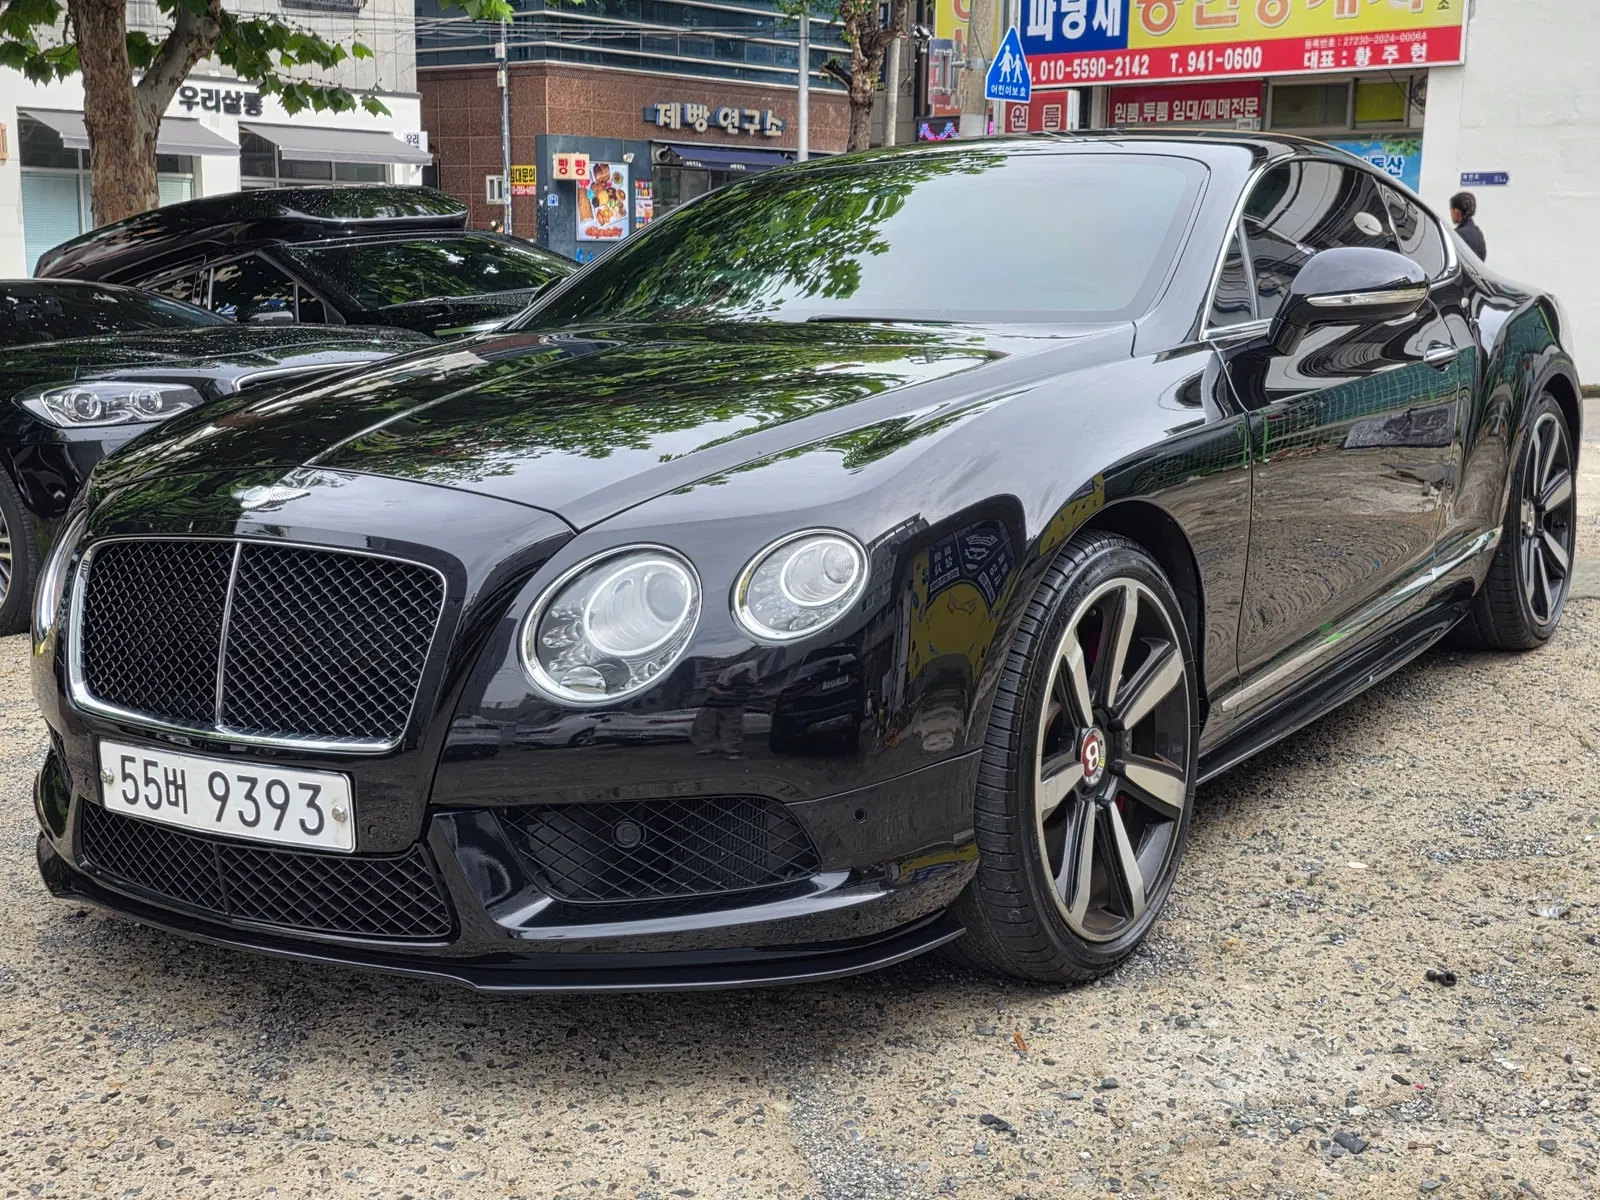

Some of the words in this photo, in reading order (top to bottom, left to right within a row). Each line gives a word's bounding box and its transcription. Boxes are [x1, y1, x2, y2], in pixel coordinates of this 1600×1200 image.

[1040, 54, 1150, 80] 010-5590-2142
[179, 86, 264, 116] 우리살롱
[990, 84, 1026, 97] 어린이보호
[119, 754, 188, 815] 55버
[207, 770, 325, 837] 9393
